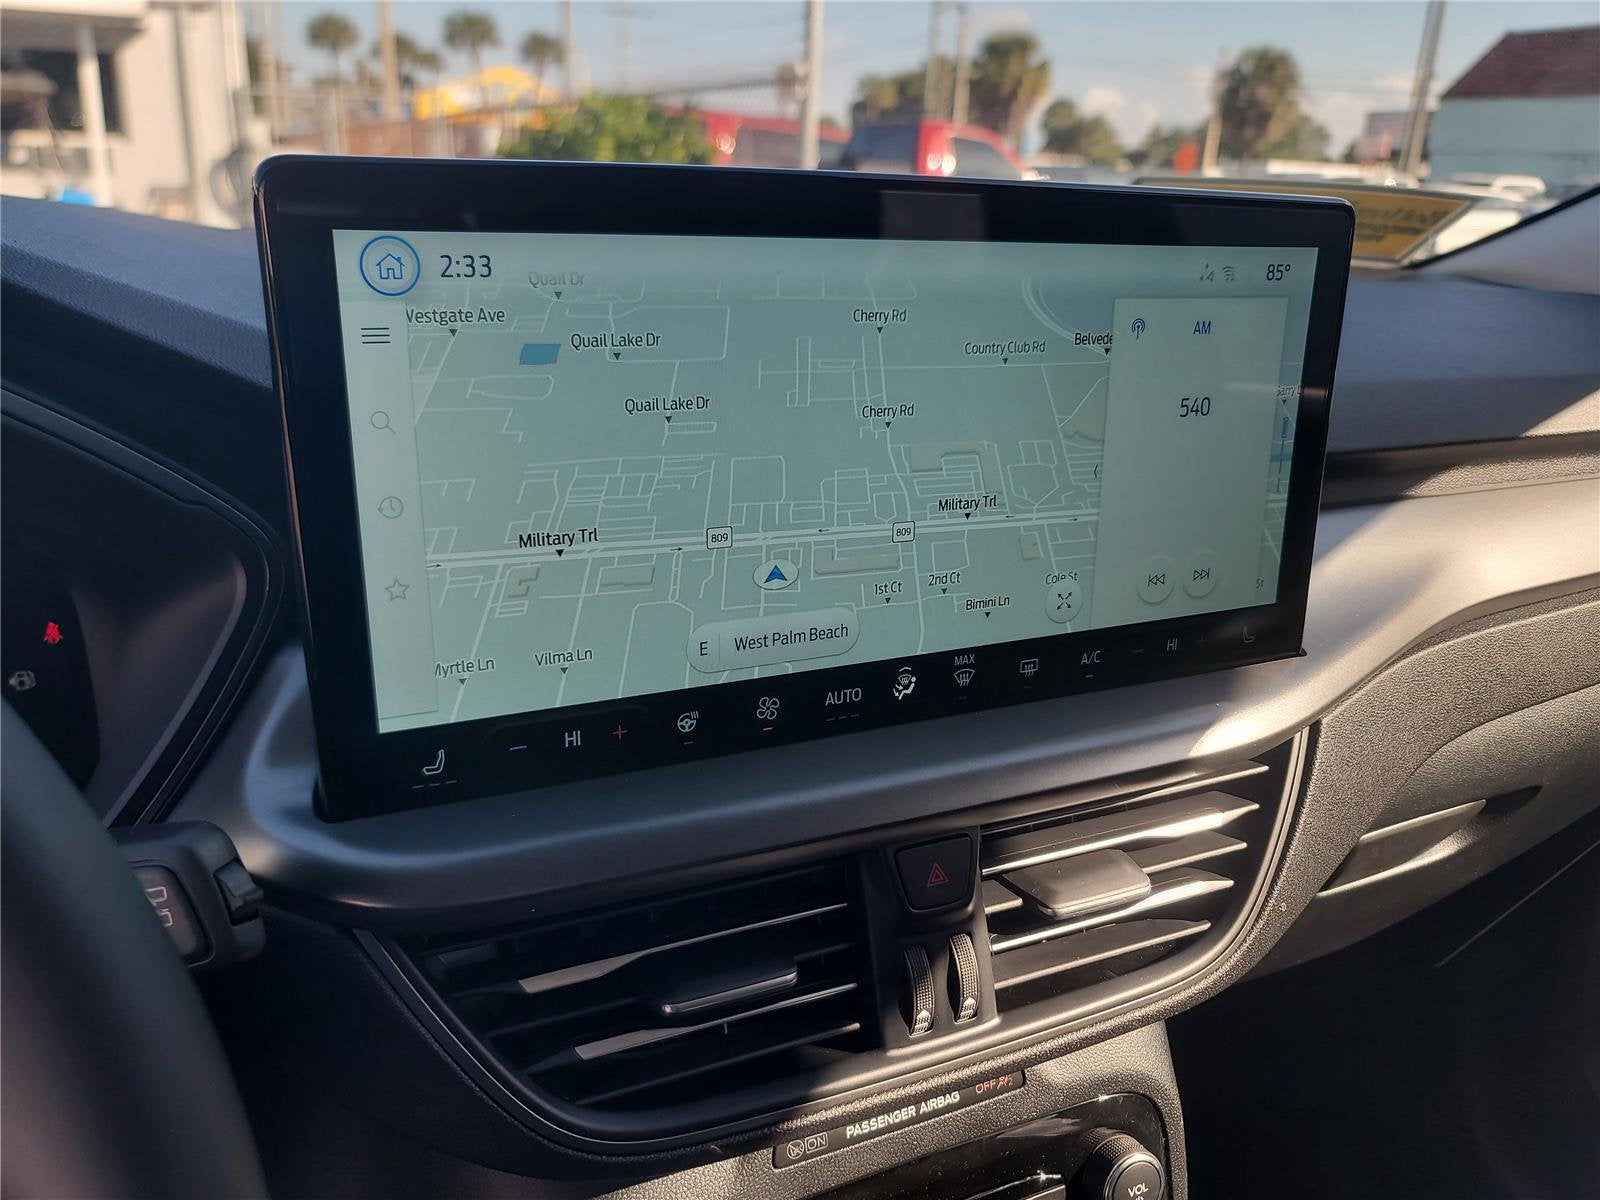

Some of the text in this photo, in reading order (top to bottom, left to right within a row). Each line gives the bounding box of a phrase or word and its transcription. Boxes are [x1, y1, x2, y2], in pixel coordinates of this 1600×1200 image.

[440, 254, 492, 279] 2:33
[1265, 263, 1291, 281] 85°
[529, 271, 585, 289] Quail Dr
[477, 307, 505, 323] Ave
[853, 308, 907, 324] Cherry Rd
[1193, 320, 1212, 335] AM
[571, 332, 661, 351] Quail Lake Dr
[965, 341, 1046, 357] Country Club Rd
[625, 396, 711, 414] Quail Lake Dr
[862, 404, 914, 420] Cherry Rd
[1179, 397, 1211, 418] 540
[938, 495, 997, 515] Military Trl
[518, 528, 599, 550] Military Trl
[710, 532, 729, 545] 809
[895, 527, 912, 538] 809
[928, 573, 961, 586] 2nd Ct
[874, 581, 902, 595] 1st Ct
[966, 596, 1010, 611] Bimini Ln
[734, 623, 849, 652] West Palm Beach
[699, 641, 708, 656] E
[1166, 639, 1178, 653] HI
[478, 659, 495, 671] Ln
[535, 648, 593, 667] Vilma Ln
[954, 654, 975, 666] MAX
[1080, 650, 1101, 666] A/C
[825, 687, 862, 706] AUTO
[565, 731, 581, 748] HI
[975, 1079, 997, 1094] OFF
[845, 1091, 960, 1139] PASSENGER AIRBAG
[807, 1134, 826, 1150] ON
[1127, 1182, 1149, 1198] VOL
